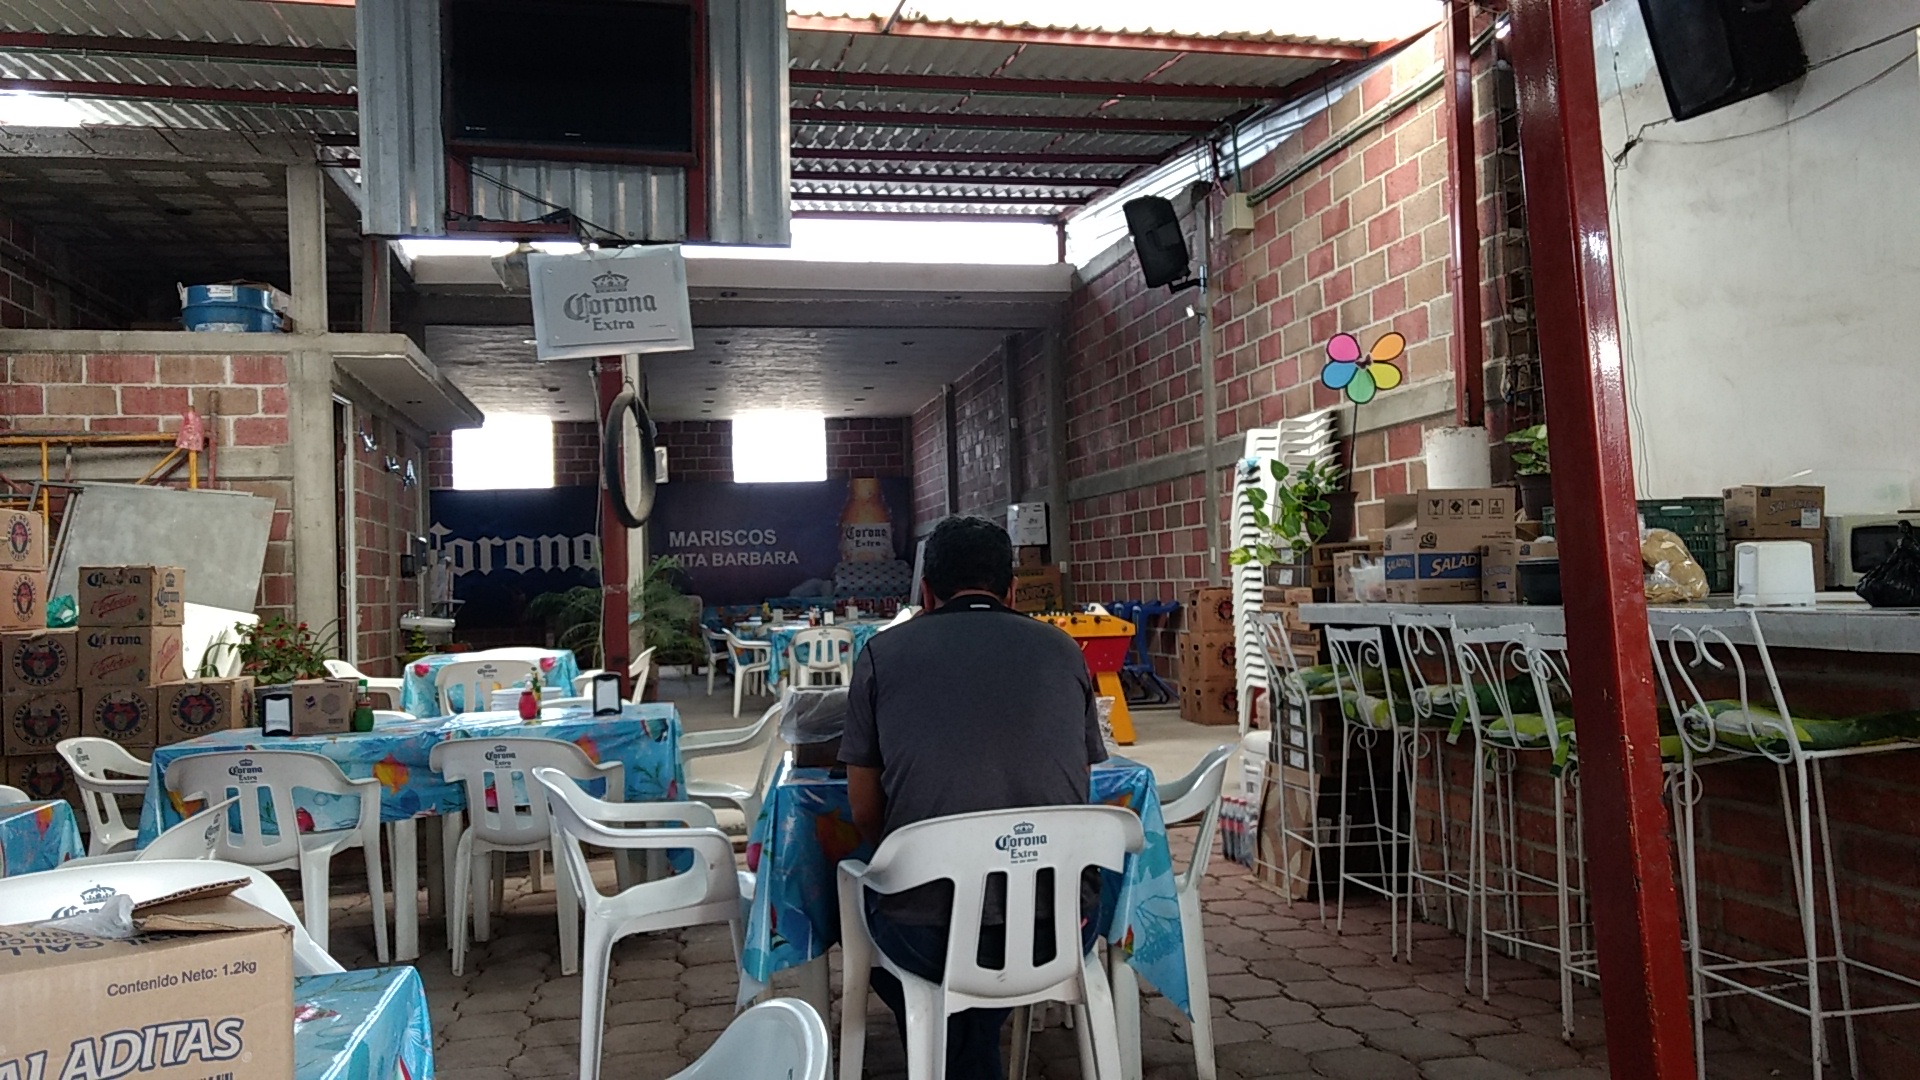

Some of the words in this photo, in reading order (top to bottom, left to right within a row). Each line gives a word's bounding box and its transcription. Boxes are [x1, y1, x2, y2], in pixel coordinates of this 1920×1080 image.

[563, 293, 658, 323] Corona
[592, 317, 635, 331] Extra
[668, 528, 777, 548] MARISCOS
[845, 526, 887, 540] Corona
[712, 550, 799, 567] BARBARA
[87, 572, 142, 588] Cooa
[485, 750, 517, 761] Corona
[228, 765, 263, 777] Corona
[995, 834, 1048, 852] Corona
[1010, 848, 1039, 859] Extra
[107, 974, 179, 997] Contenido
[181, 967, 218, 983] Neto:
[222, 960, 257, 976] 1.2kg
